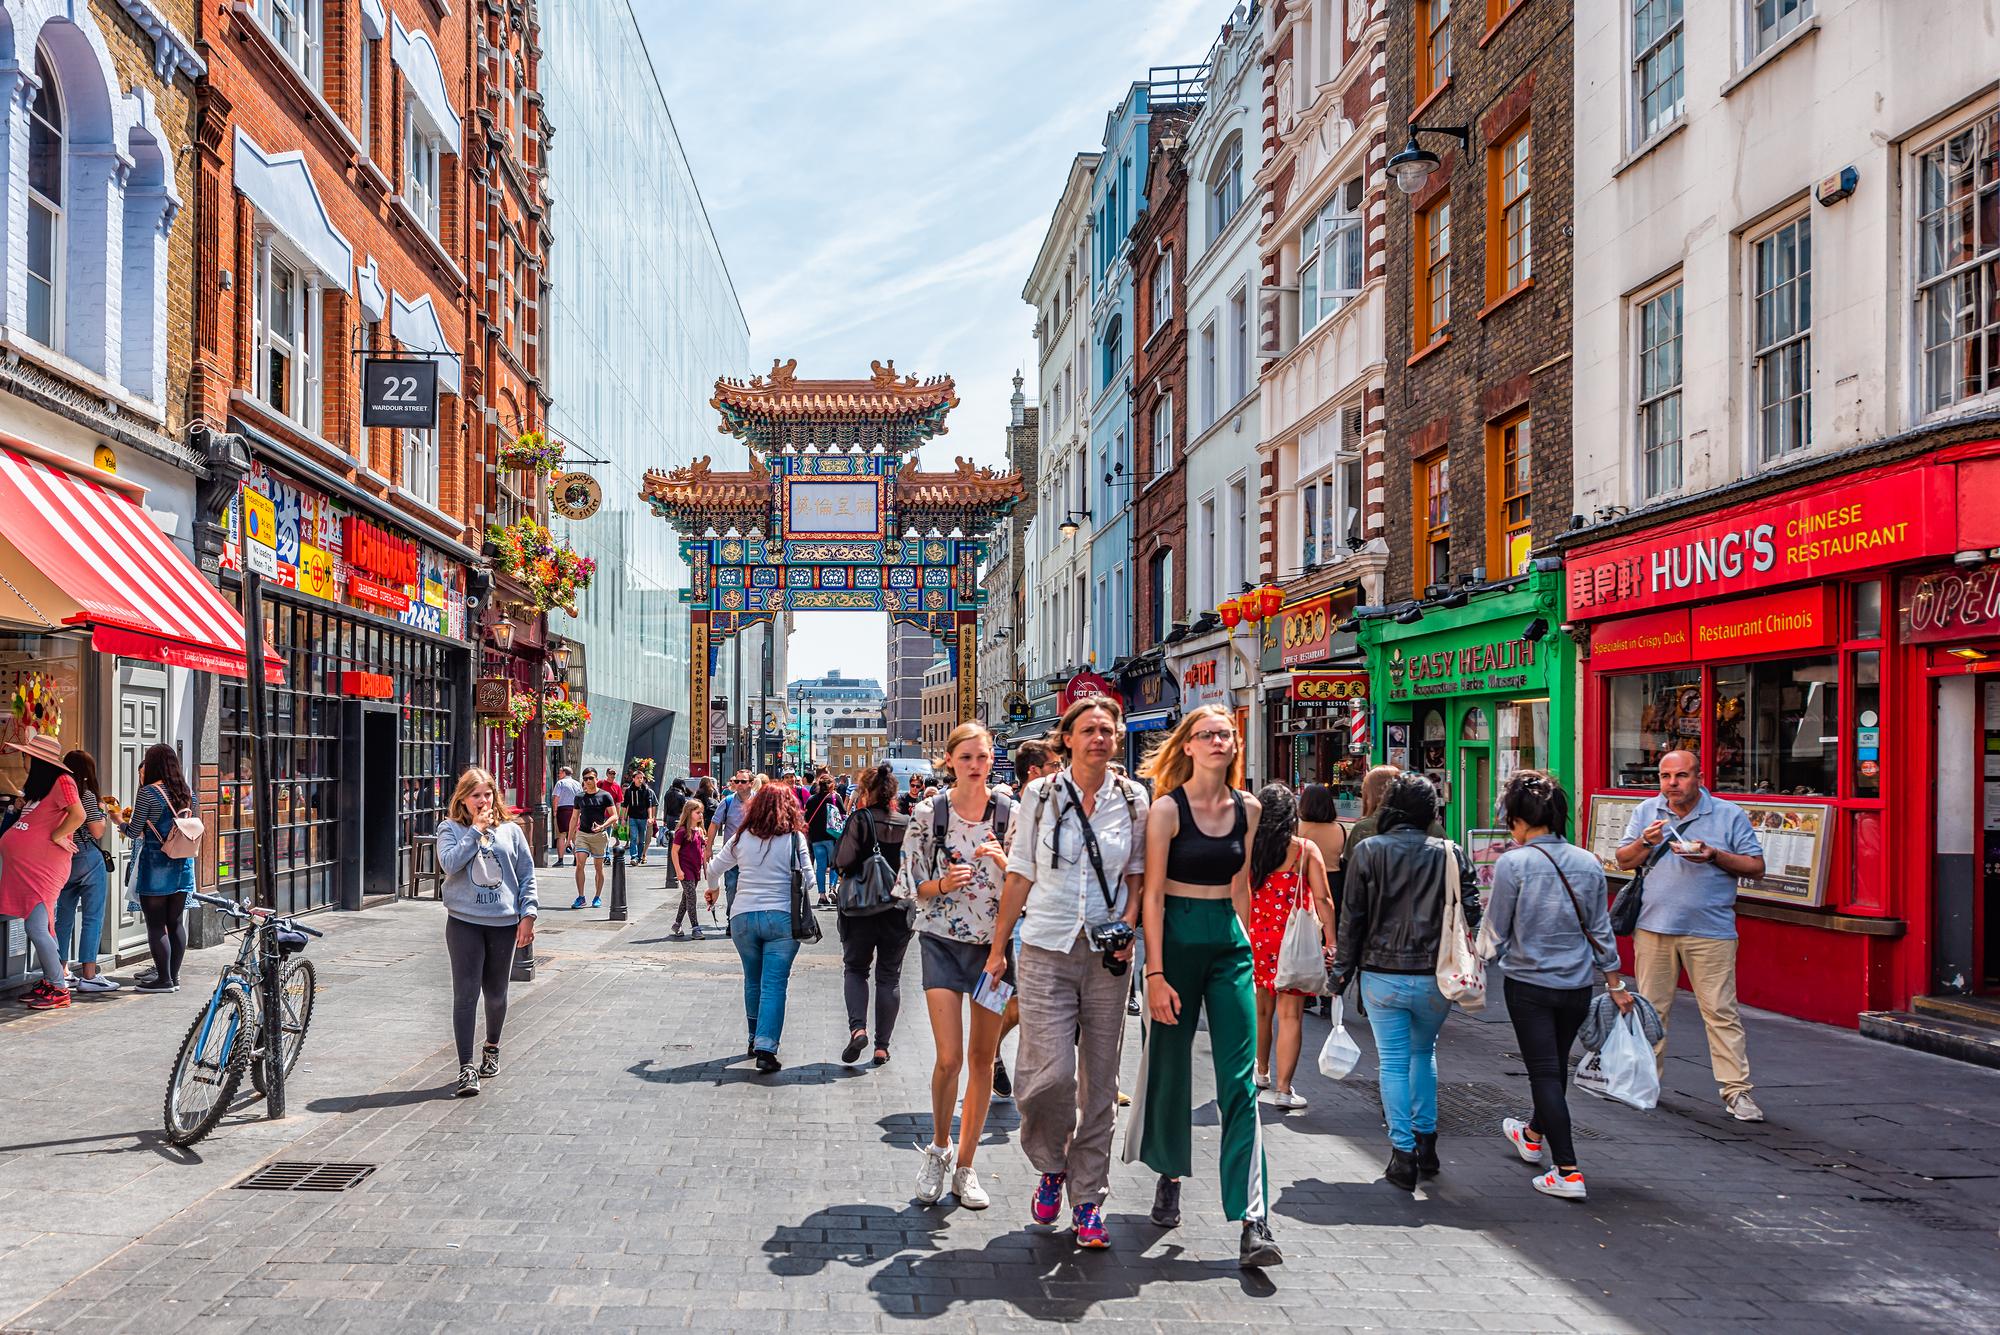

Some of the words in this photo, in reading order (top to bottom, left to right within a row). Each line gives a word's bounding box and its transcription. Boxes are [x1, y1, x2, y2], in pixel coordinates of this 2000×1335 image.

[383, 376, 417, 401] 22
[1786, 503, 1862, 538] CHINESE
[352, 516, 417, 586] ICHIBUNS
[1651, 523, 1776, 593] HUNG'S
[1786, 522, 1909, 565] RESTAURANT
[1573, 555, 1644, 610] 美食軒
[1594, 637, 1628, 655] Specialist
[1629, 639, 1637, 650] in
[1638, 633, 1662, 650] Crispy
[1664, 630, 1686, 645] Duck
[1699, 617, 1763, 642] Restaurant
[1766, 610, 1813, 634] Chinois
[1409, 651, 1454, 681] EASY
[1459, 639, 1535, 675] HEALTH
[361, 672, 394, 698] ICHIBUNS
[1300, 681, 1362, 697] 文興酒家
[476, 894, 488, 905] ALL
[489, 892, 502, 904] DAY
